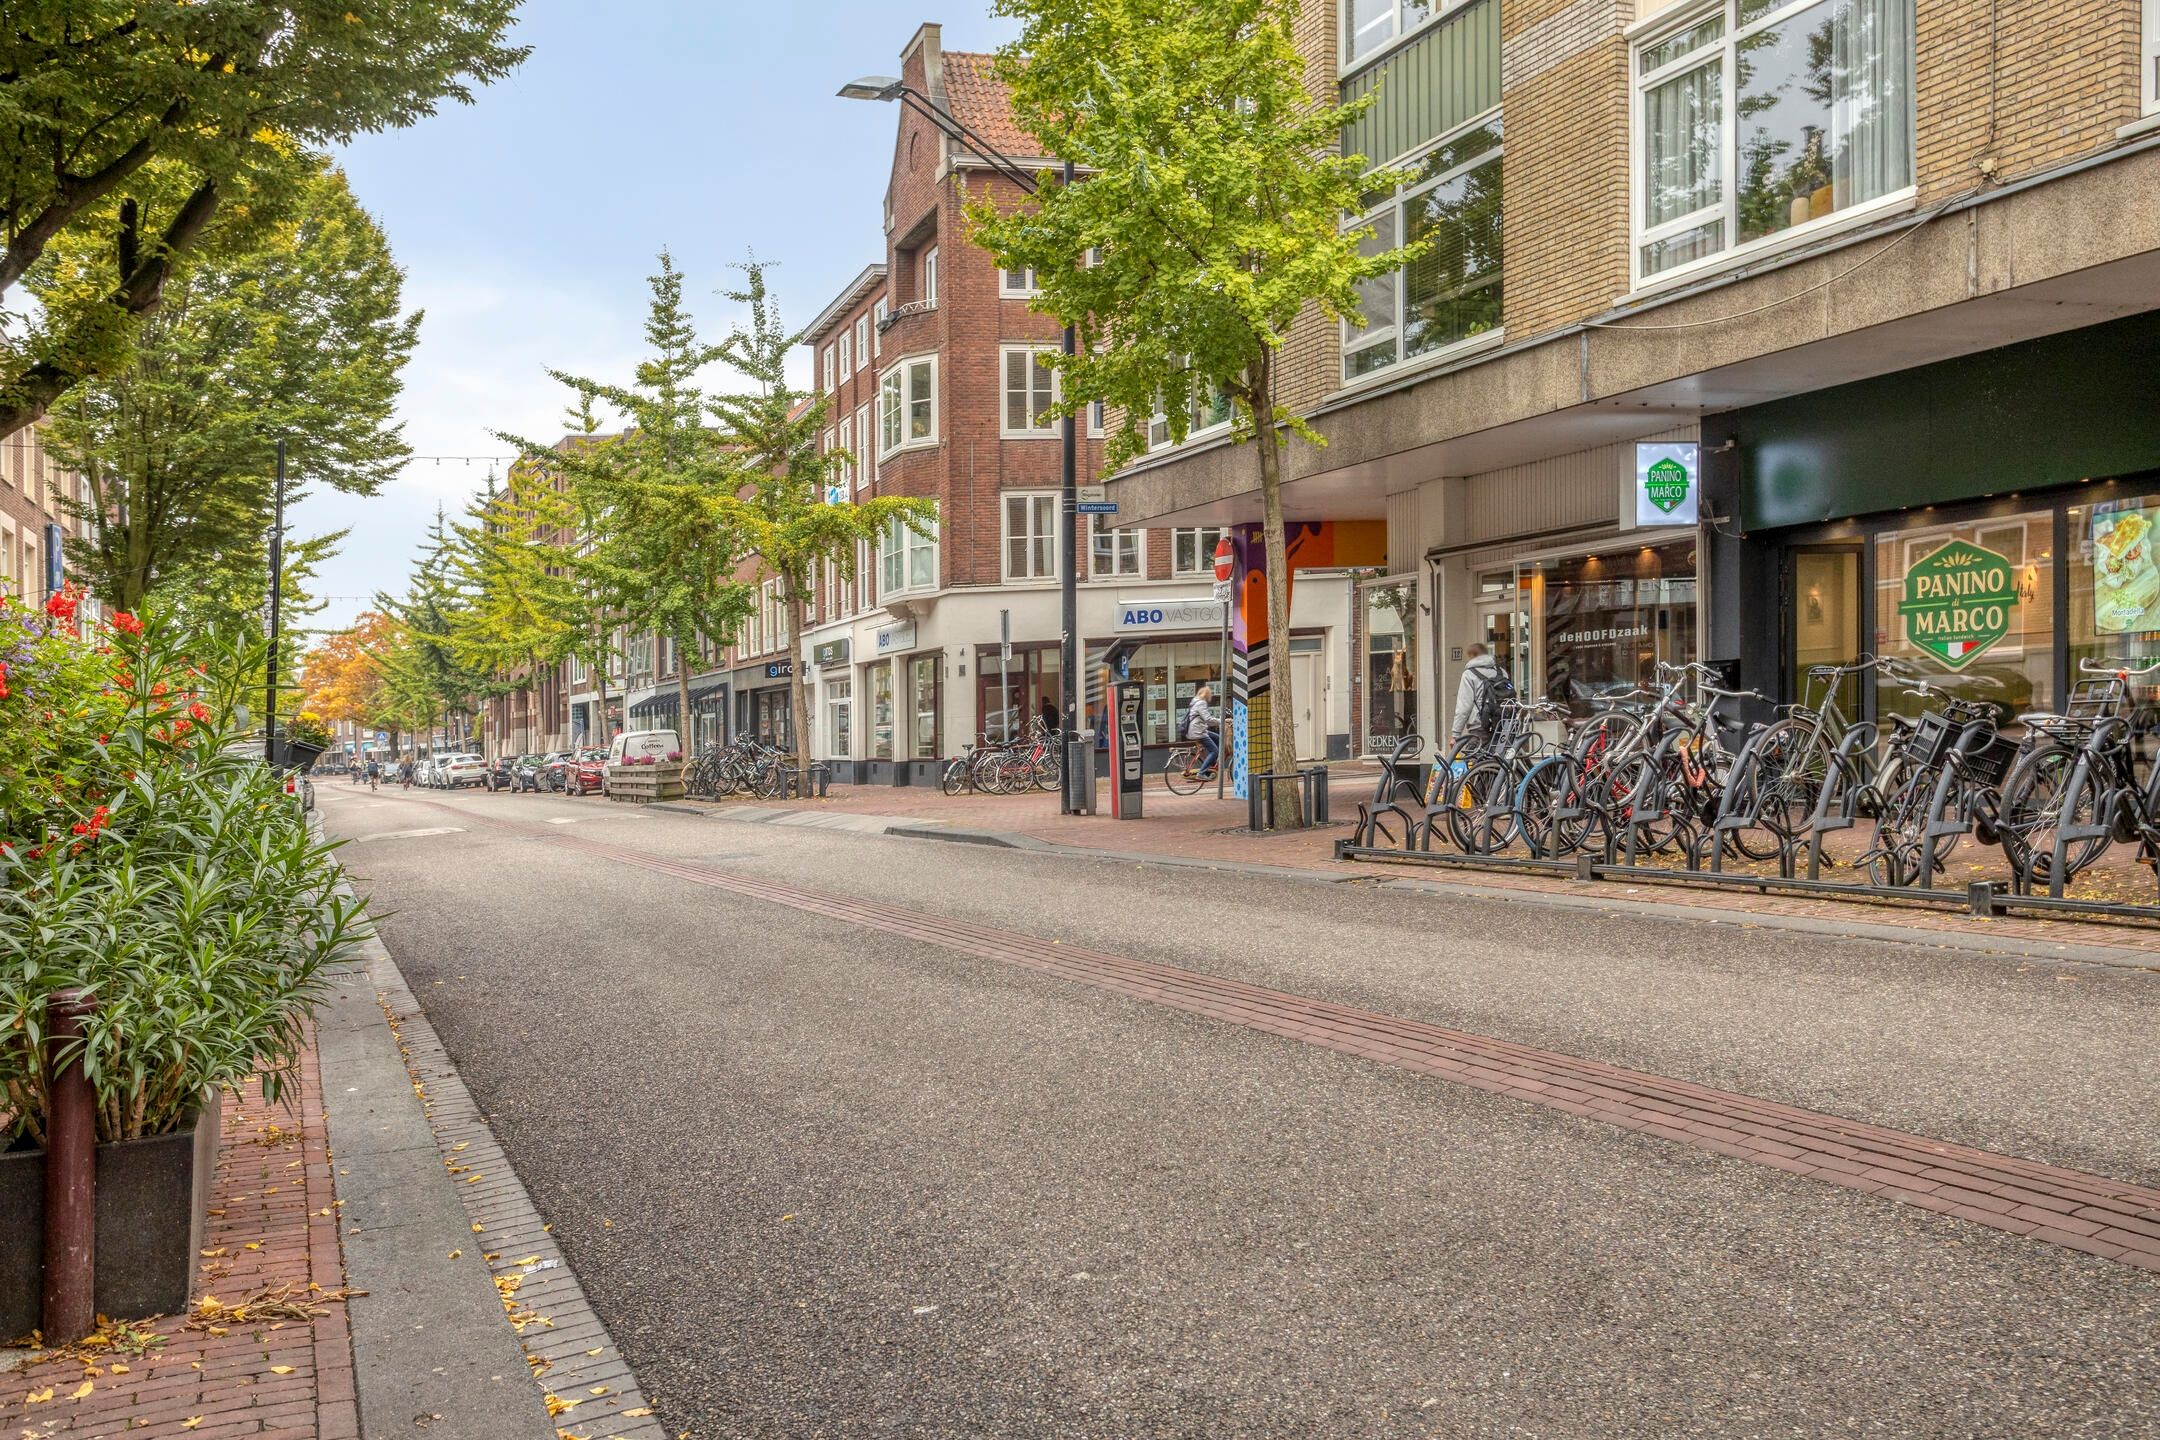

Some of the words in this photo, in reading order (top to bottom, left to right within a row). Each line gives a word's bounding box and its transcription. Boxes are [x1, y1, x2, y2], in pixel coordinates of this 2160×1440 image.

[1650, 470, 1681, 482] PANINO
[1650, 486, 1682, 498] MARCO
[1916, 568, 2005, 599] PANINO
[1951, 598, 1960, 607] di
[1123, 609, 1163, 624] ABO
[1166, 607, 1223, 621] VASTGO
[2112, 607, 2145, 616] Mortadella
[1915, 605, 2003, 635] MARCO
[879, 632, 889, 648] ABO
[1559, 624, 1648, 643] deHOOFDzaak
[769, 664, 793, 677] giro
[1367, 735, 1398, 747] REDKEN
